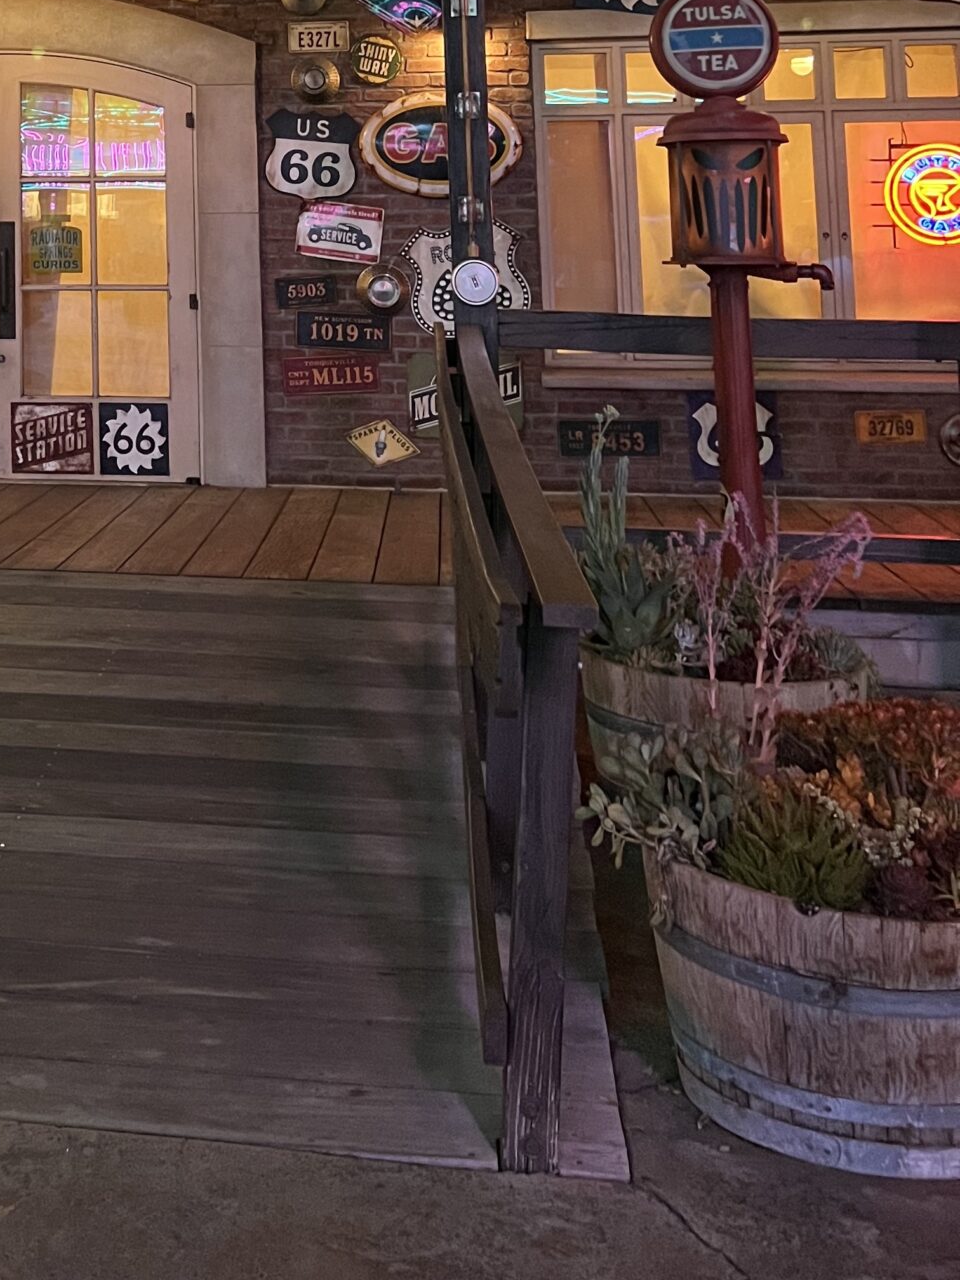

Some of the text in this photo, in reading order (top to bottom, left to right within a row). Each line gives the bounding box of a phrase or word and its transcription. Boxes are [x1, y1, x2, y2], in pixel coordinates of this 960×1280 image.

[682, 4, 748, 23] TULSA
[298, 31, 340, 49] E327L
[358, 42, 397, 63] SHINY
[696, 53, 739, 72] TEA
[359, 57, 391, 77] WAX
[296, 118, 331, 139] US
[280, 148, 342, 188] 66
[31, 229, 79, 246] RADIATOR
[320, 228, 358, 245] SERVICE
[39, 245, 73, 259] SPRINGS
[33, 260, 79, 270] CURIOS
[287, 282, 326, 298] 5903
[310, 322, 384, 342] 1019 TN
[311, 365, 374, 386] ML115
[14, 409, 87, 444] SERVICE
[868, 418, 914, 437] 32769
[15, 428, 88, 465] STATION
[112, 421, 157, 455] 66
[353, 426, 412, 452] SPARK PLUGS
